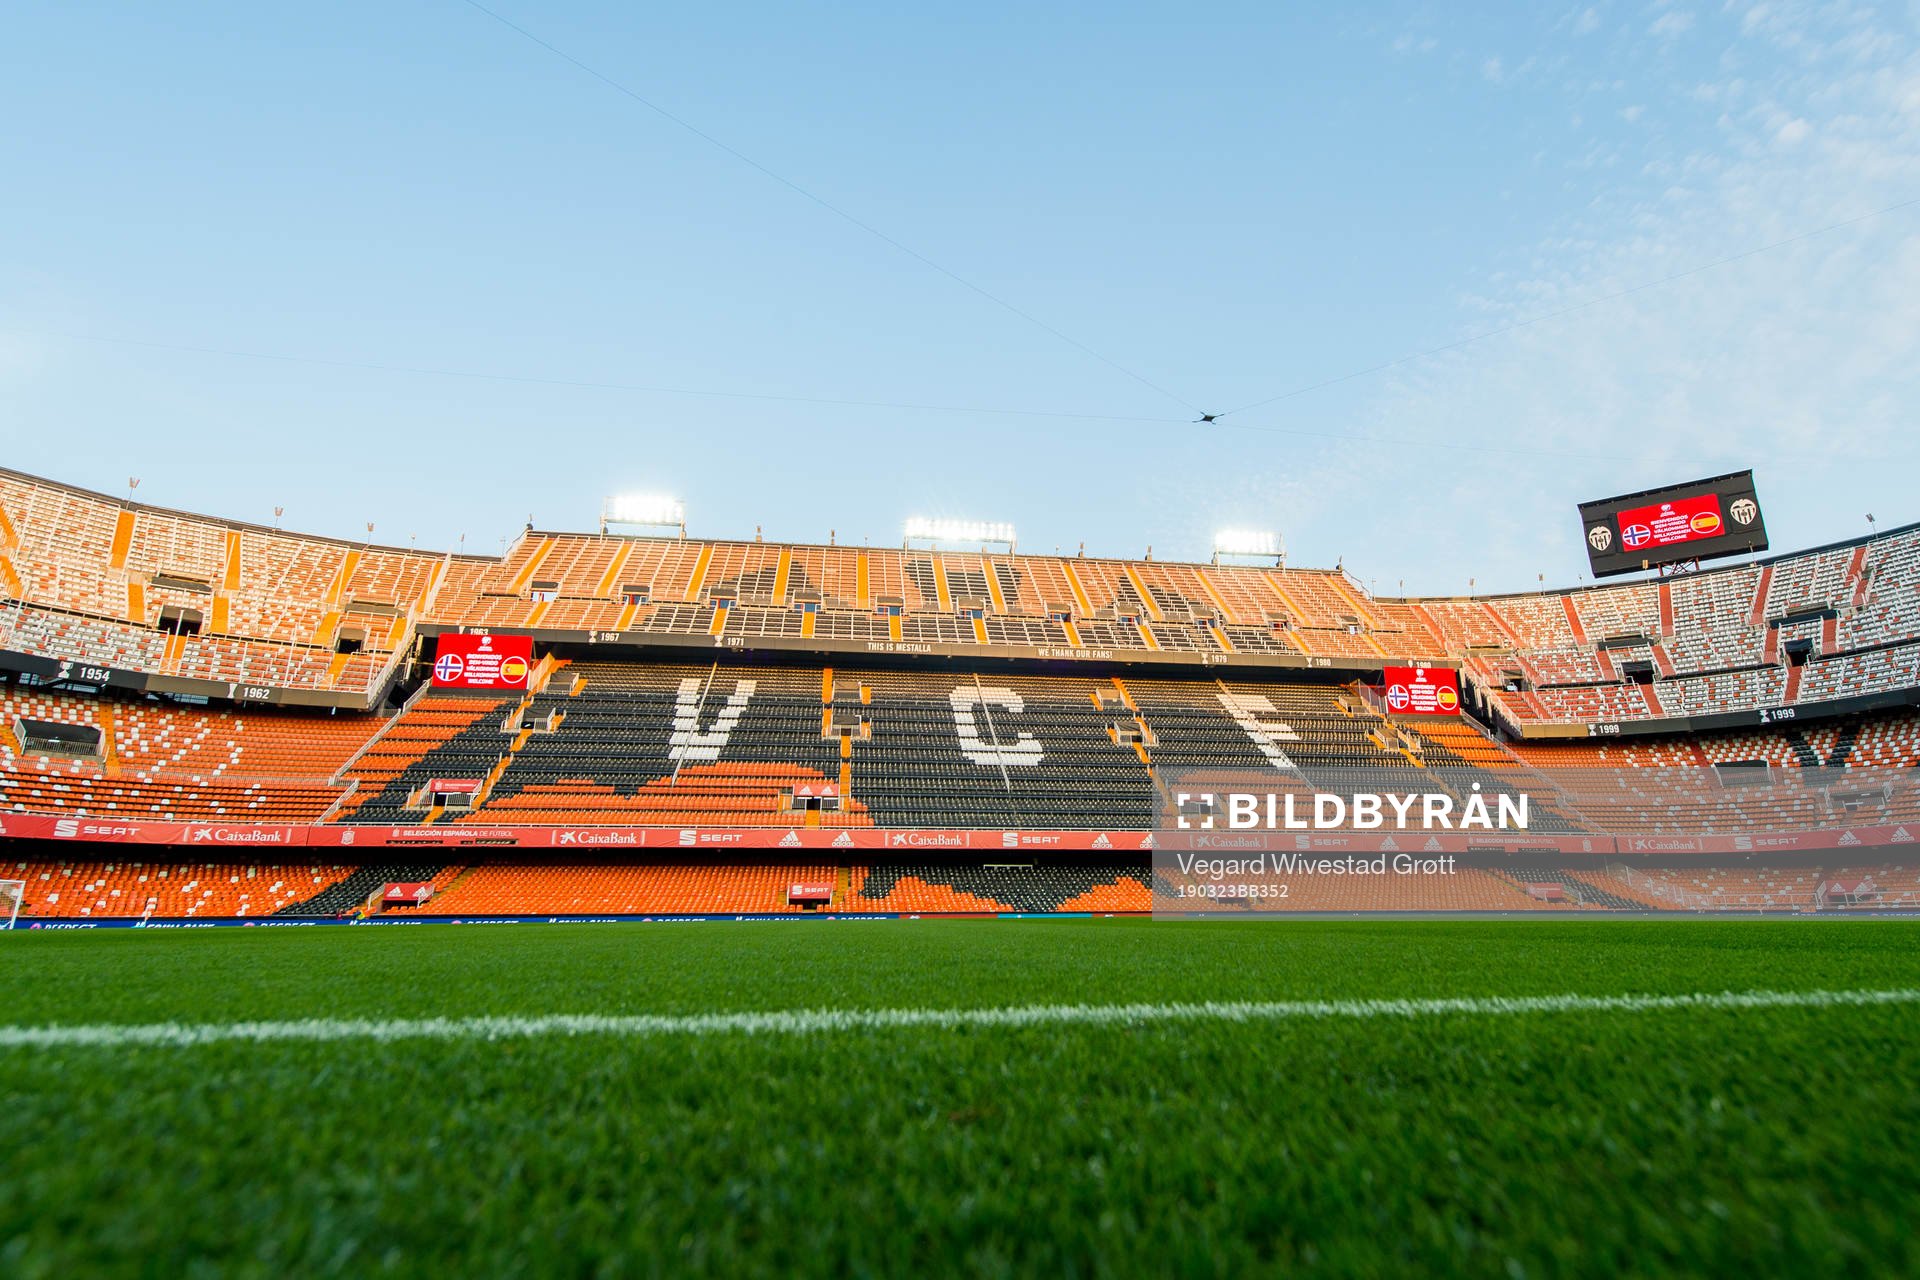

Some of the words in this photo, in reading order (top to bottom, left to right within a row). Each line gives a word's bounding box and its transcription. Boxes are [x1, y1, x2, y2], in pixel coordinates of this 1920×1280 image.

[600, 632, 620, 642] 1967
[727, 637, 745, 646] 1971
[867, 642, 883, 651] THIS
[886, 643, 894, 651] IS
[895, 643, 932, 653] MESTALLA
[1038, 648, 1050, 657] WE
[1051, 649, 1074, 658] THANK
[1075, 649, 1091, 658] OUR
[1092, 650, 1113, 659] FANS!
[79, 666, 111, 682] 1954
[243, 687, 271, 700] 1962
[1771, 708, 1796, 720] 1999
[83, 825, 140, 836] SEAT
[215, 828, 281, 842] CaixaBank
[577, 831, 638, 844] CaixaBank
[700, 834, 743, 842] SEAT
[908, 834, 963, 846] CaixaBank
[1021, 836, 1061, 844] SEAT
[1211, 835, 1261, 848] CaixaBank
[1313, 838, 1349, 846] SEAT
[1756, 837, 1799, 846] SEAT
[1648, 839, 1696, 850] CaixaBank
